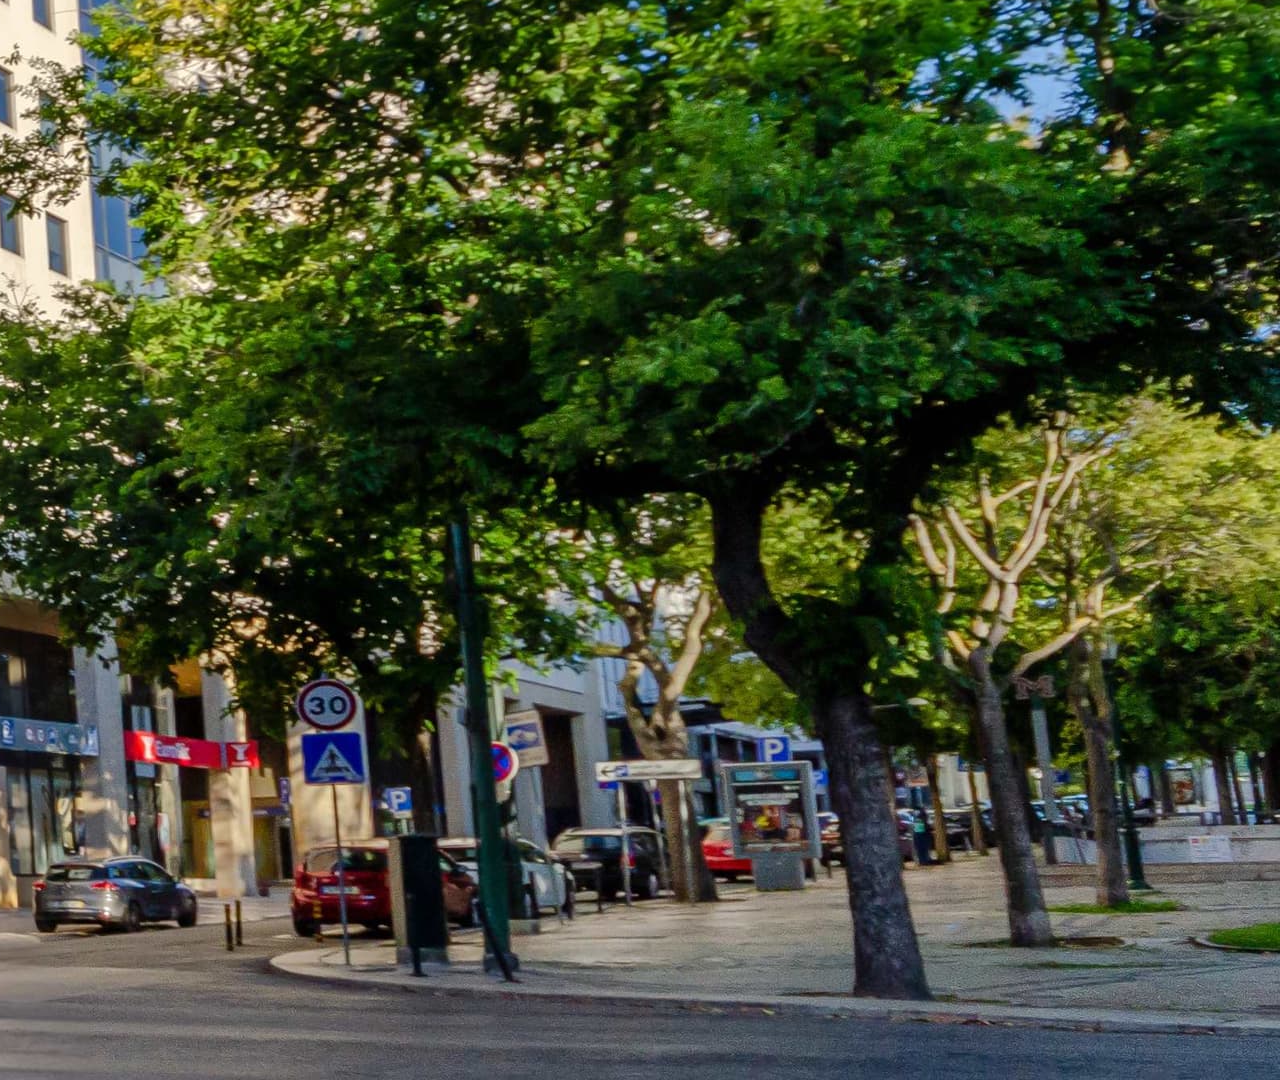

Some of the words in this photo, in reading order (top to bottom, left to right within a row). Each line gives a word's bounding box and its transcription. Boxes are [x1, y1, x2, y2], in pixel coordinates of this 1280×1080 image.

[309, 696, 347, 715] 30
[764, 739, 784, 761] P
[392, 790, 407, 809] P
